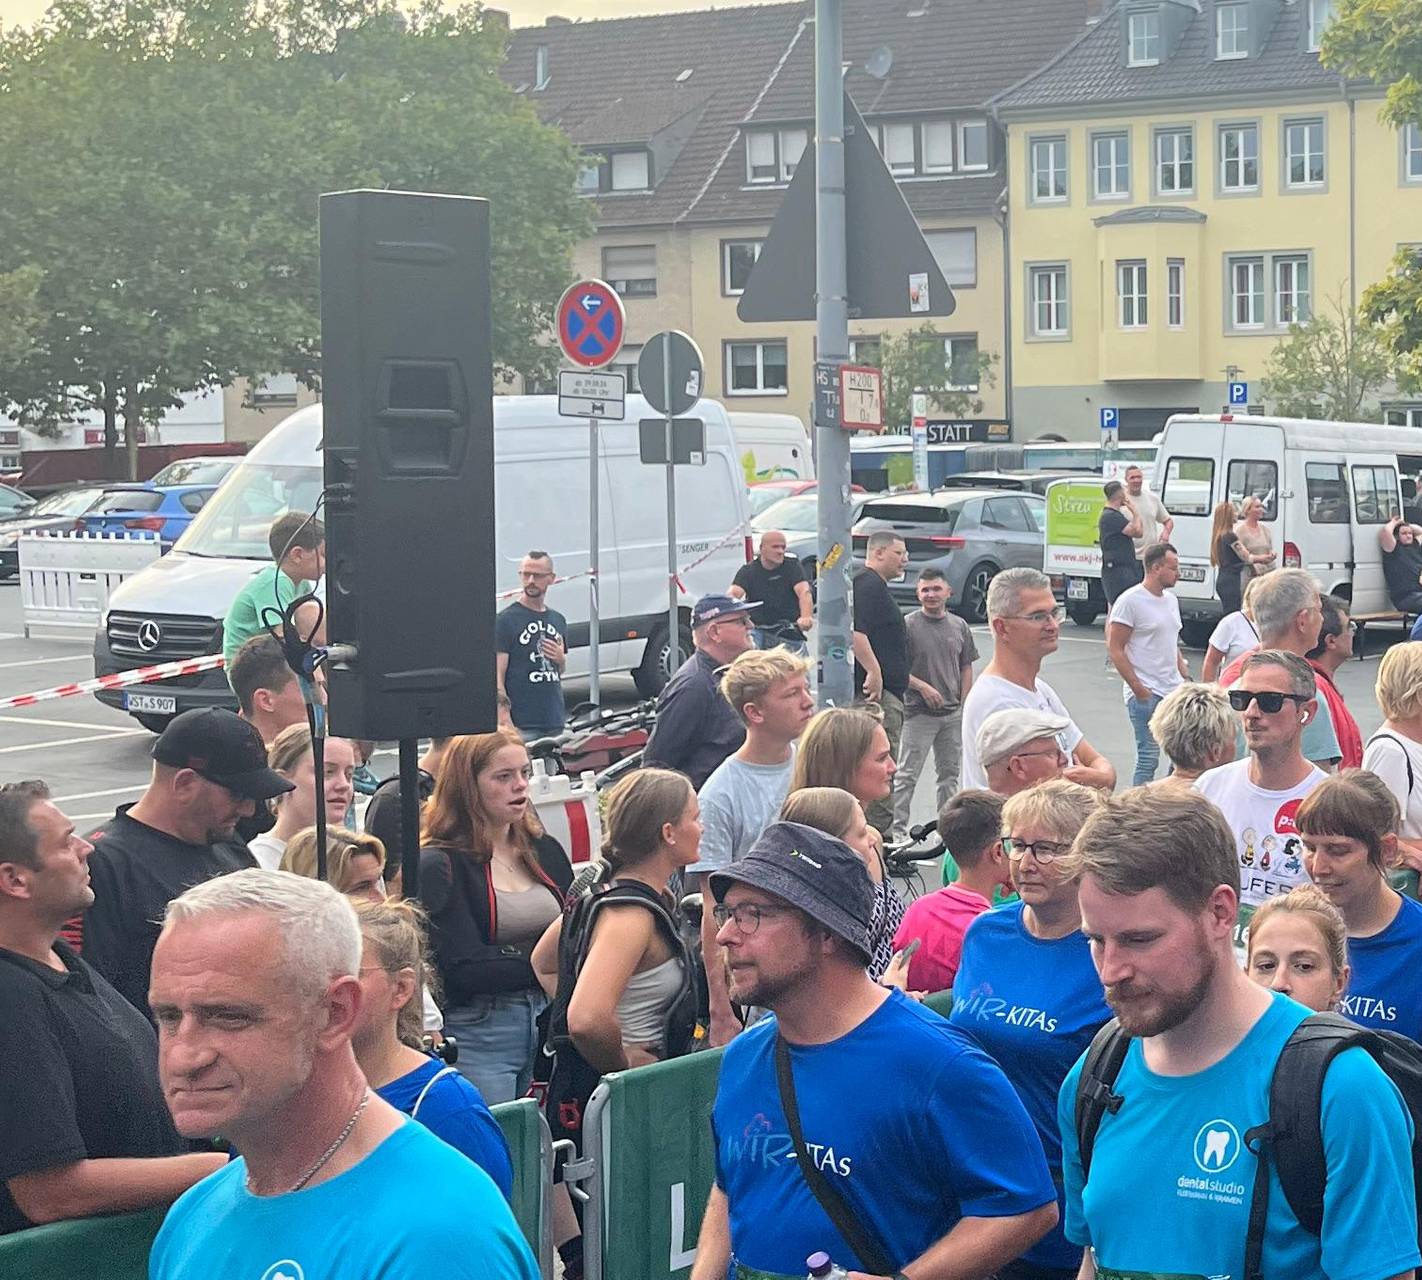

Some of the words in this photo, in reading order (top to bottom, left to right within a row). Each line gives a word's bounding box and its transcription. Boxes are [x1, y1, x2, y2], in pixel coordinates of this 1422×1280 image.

[1233, 385, 1244, 401] P
[1103, 409, 1114, 427] P
[1340, 994, 1397, 1021] KITAs
